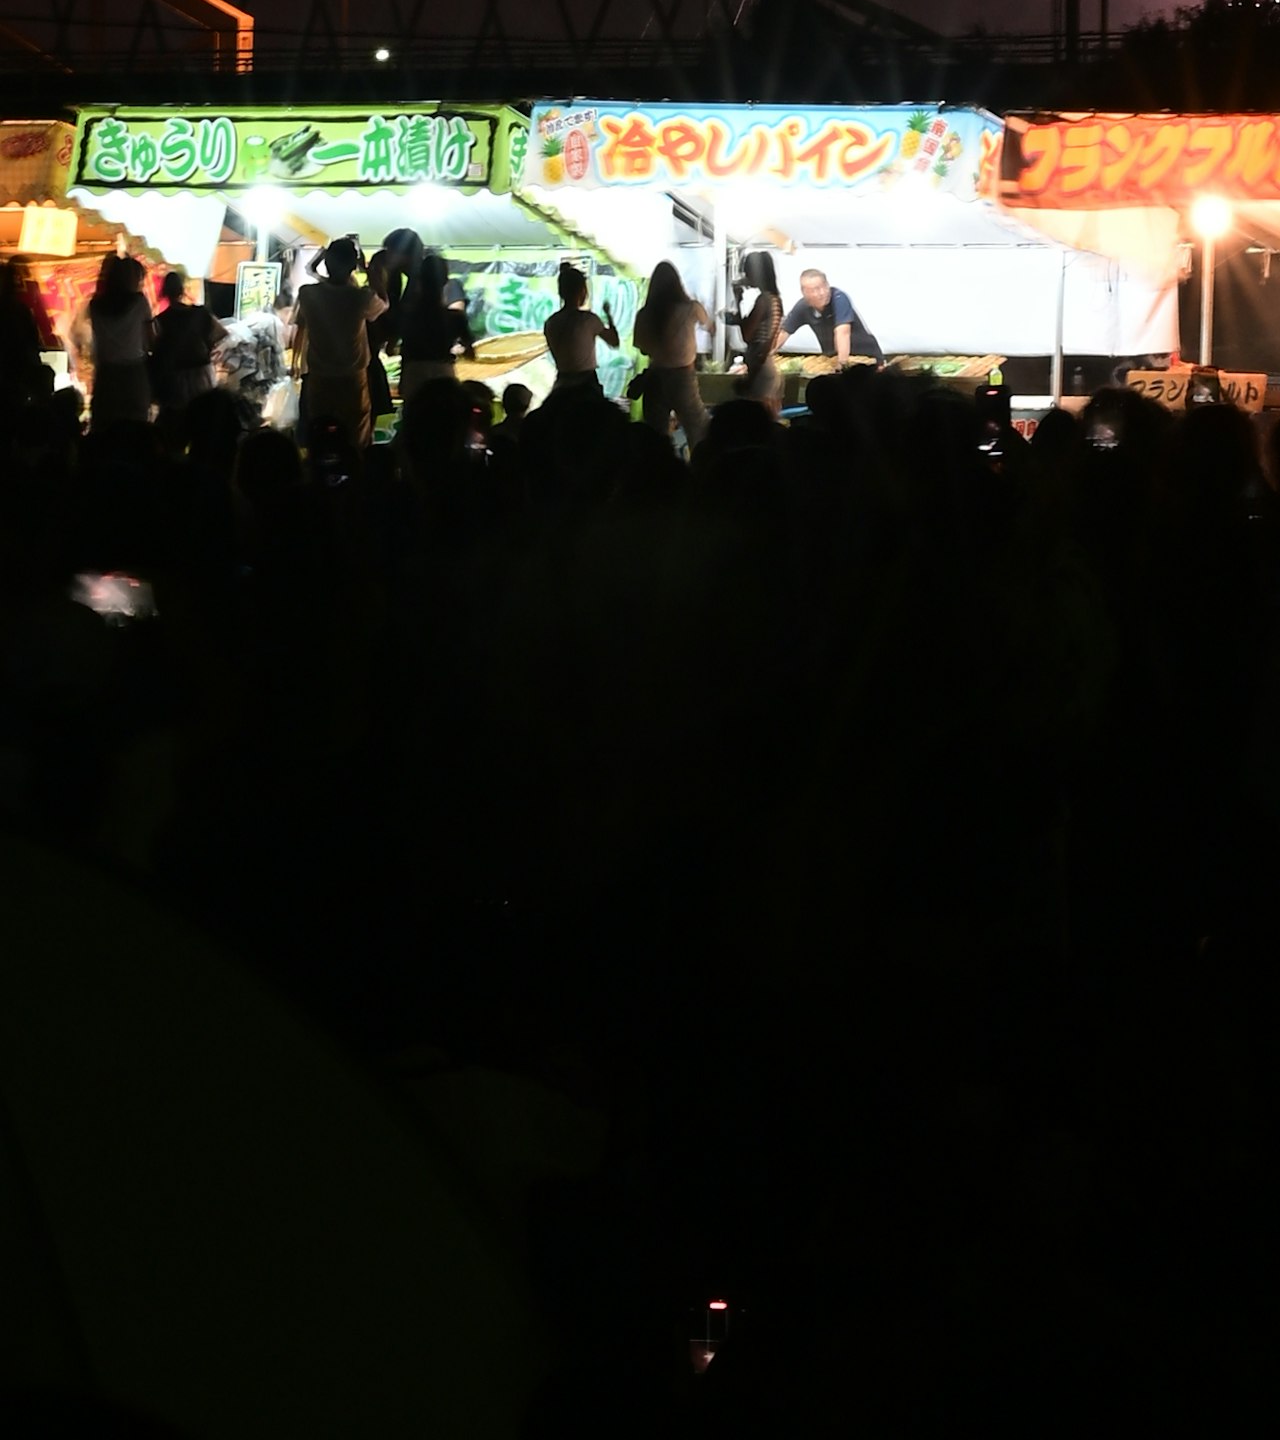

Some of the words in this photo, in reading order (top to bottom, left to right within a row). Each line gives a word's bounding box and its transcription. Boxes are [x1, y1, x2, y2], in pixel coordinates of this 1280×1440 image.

[95, 119, 236, 181] きゅうり
[309, 118, 473, 180] 一本漬け
[601, 118, 890, 179] 冷やしパイン
